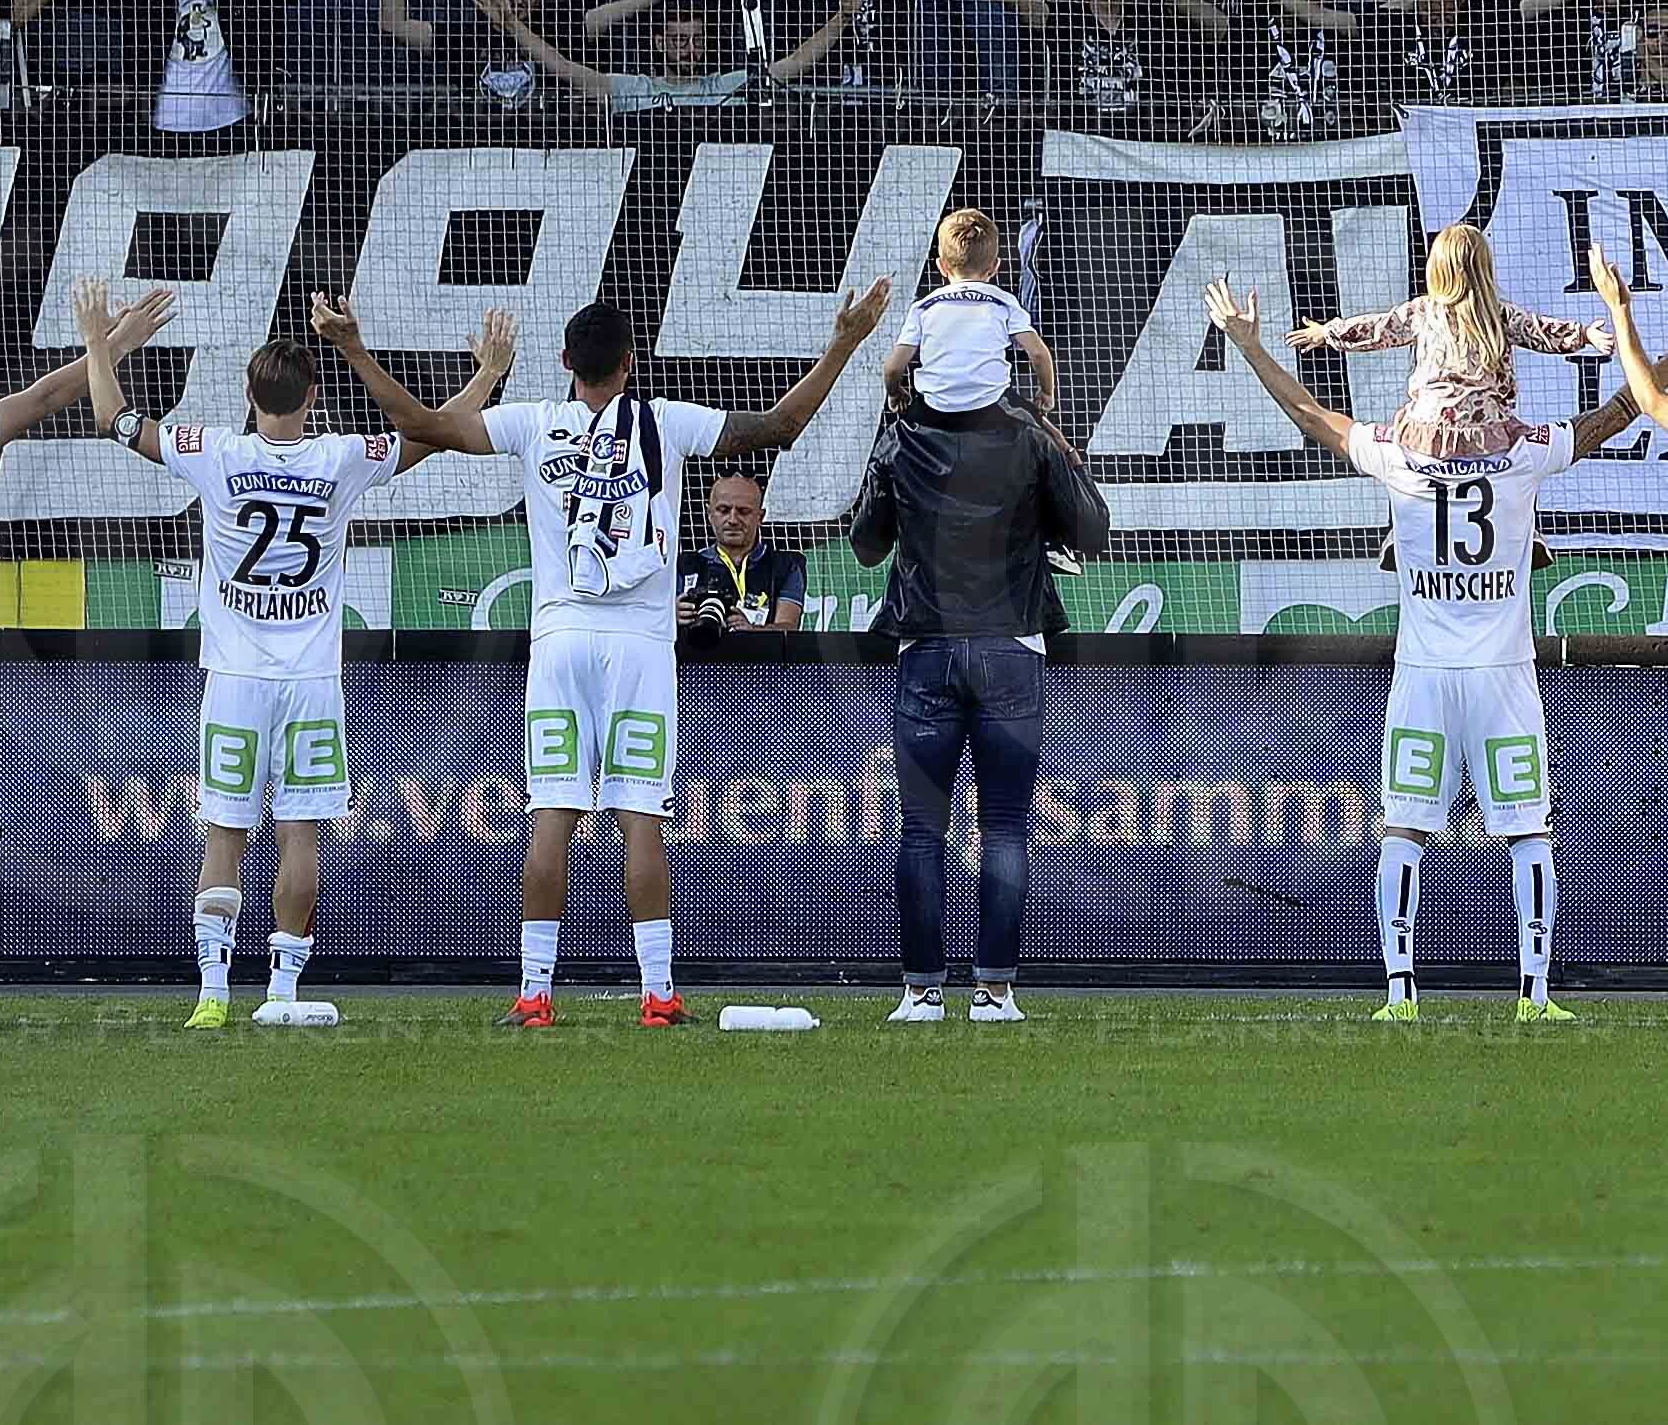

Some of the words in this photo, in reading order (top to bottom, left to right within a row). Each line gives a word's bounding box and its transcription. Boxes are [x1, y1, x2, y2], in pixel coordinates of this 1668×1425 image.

[228, 474, 335, 500] PUNTIGAMER
[232, 502, 329, 587] 25
[1427, 476, 1497, 566] 13
[218, 581, 329, 622] HIERLÄNDER
